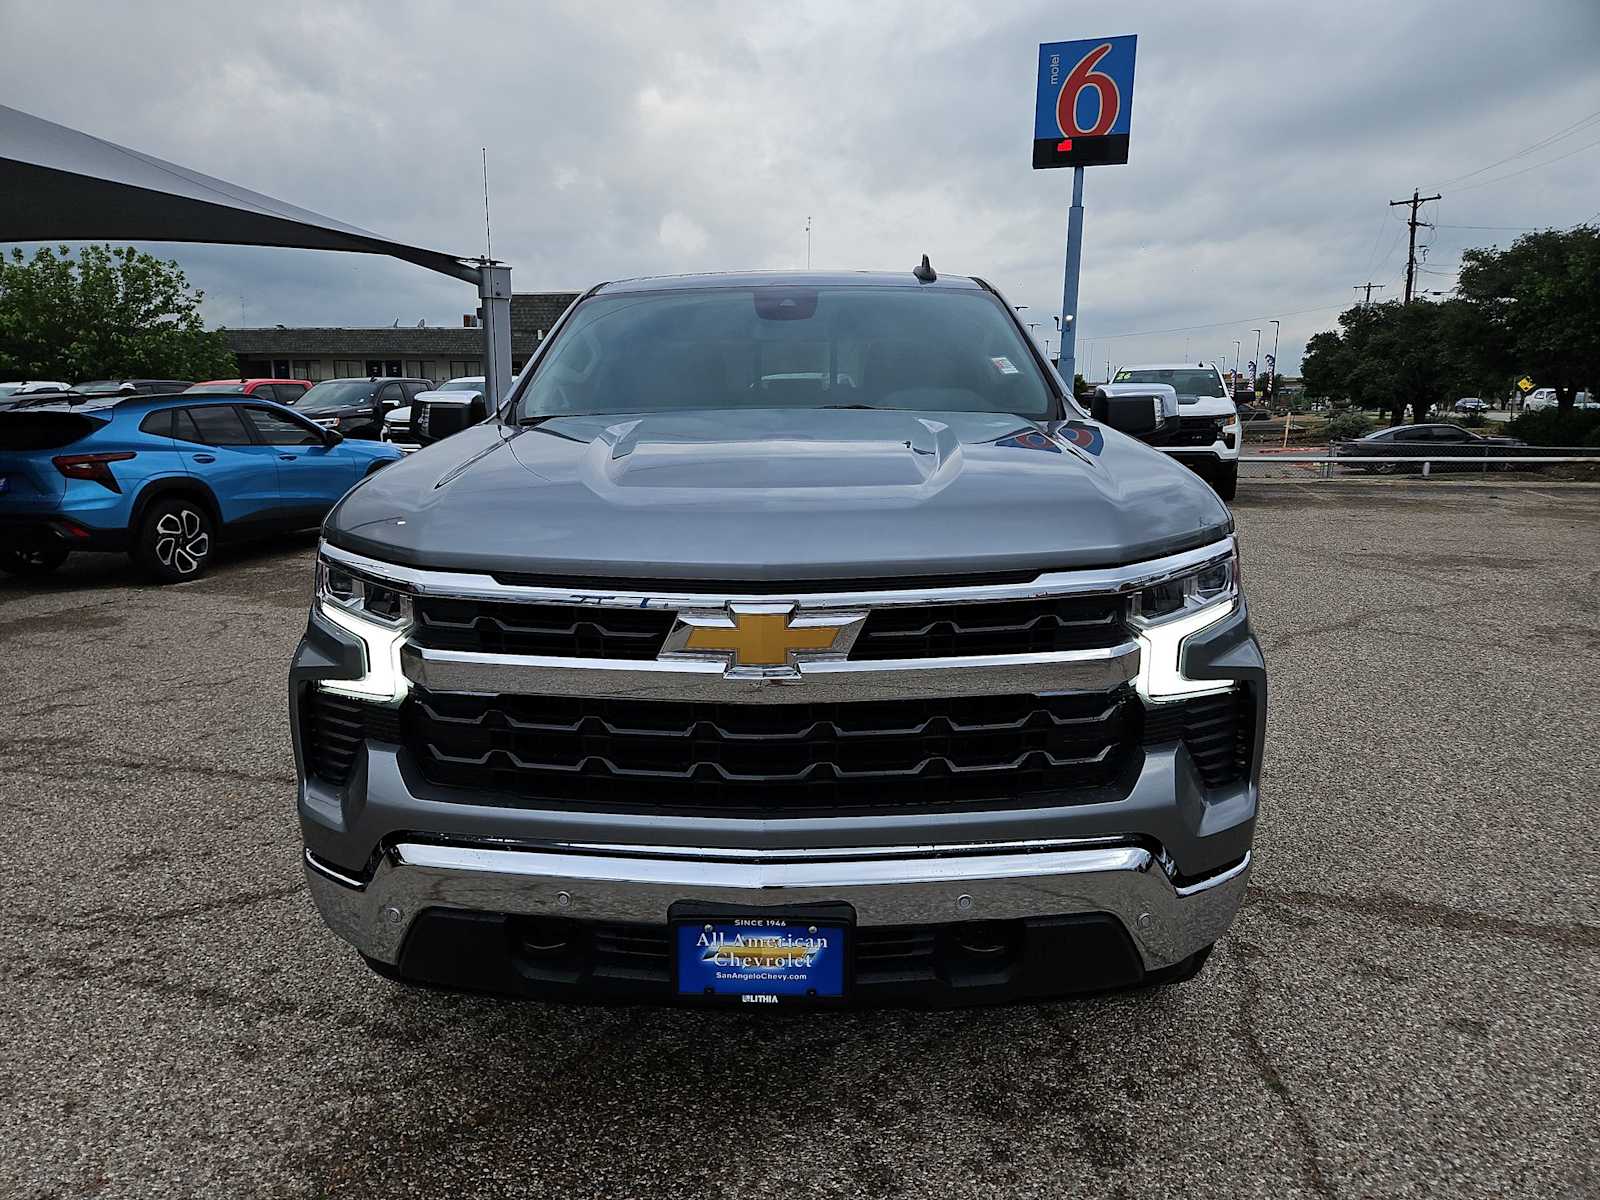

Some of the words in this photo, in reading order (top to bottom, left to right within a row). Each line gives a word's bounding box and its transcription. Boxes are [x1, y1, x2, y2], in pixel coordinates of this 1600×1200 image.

[1050, 54, 1060, 85] motel
[1056, 43, 1120, 137] 6
[734, 919, 764, 927] SINCE
[696, 932, 724, 947] All
[733, 932, 828, 948] American
[713, 951, 812, 968] Chevrolet
[715, 972, 807, 981] SanAngeloChevy.com
